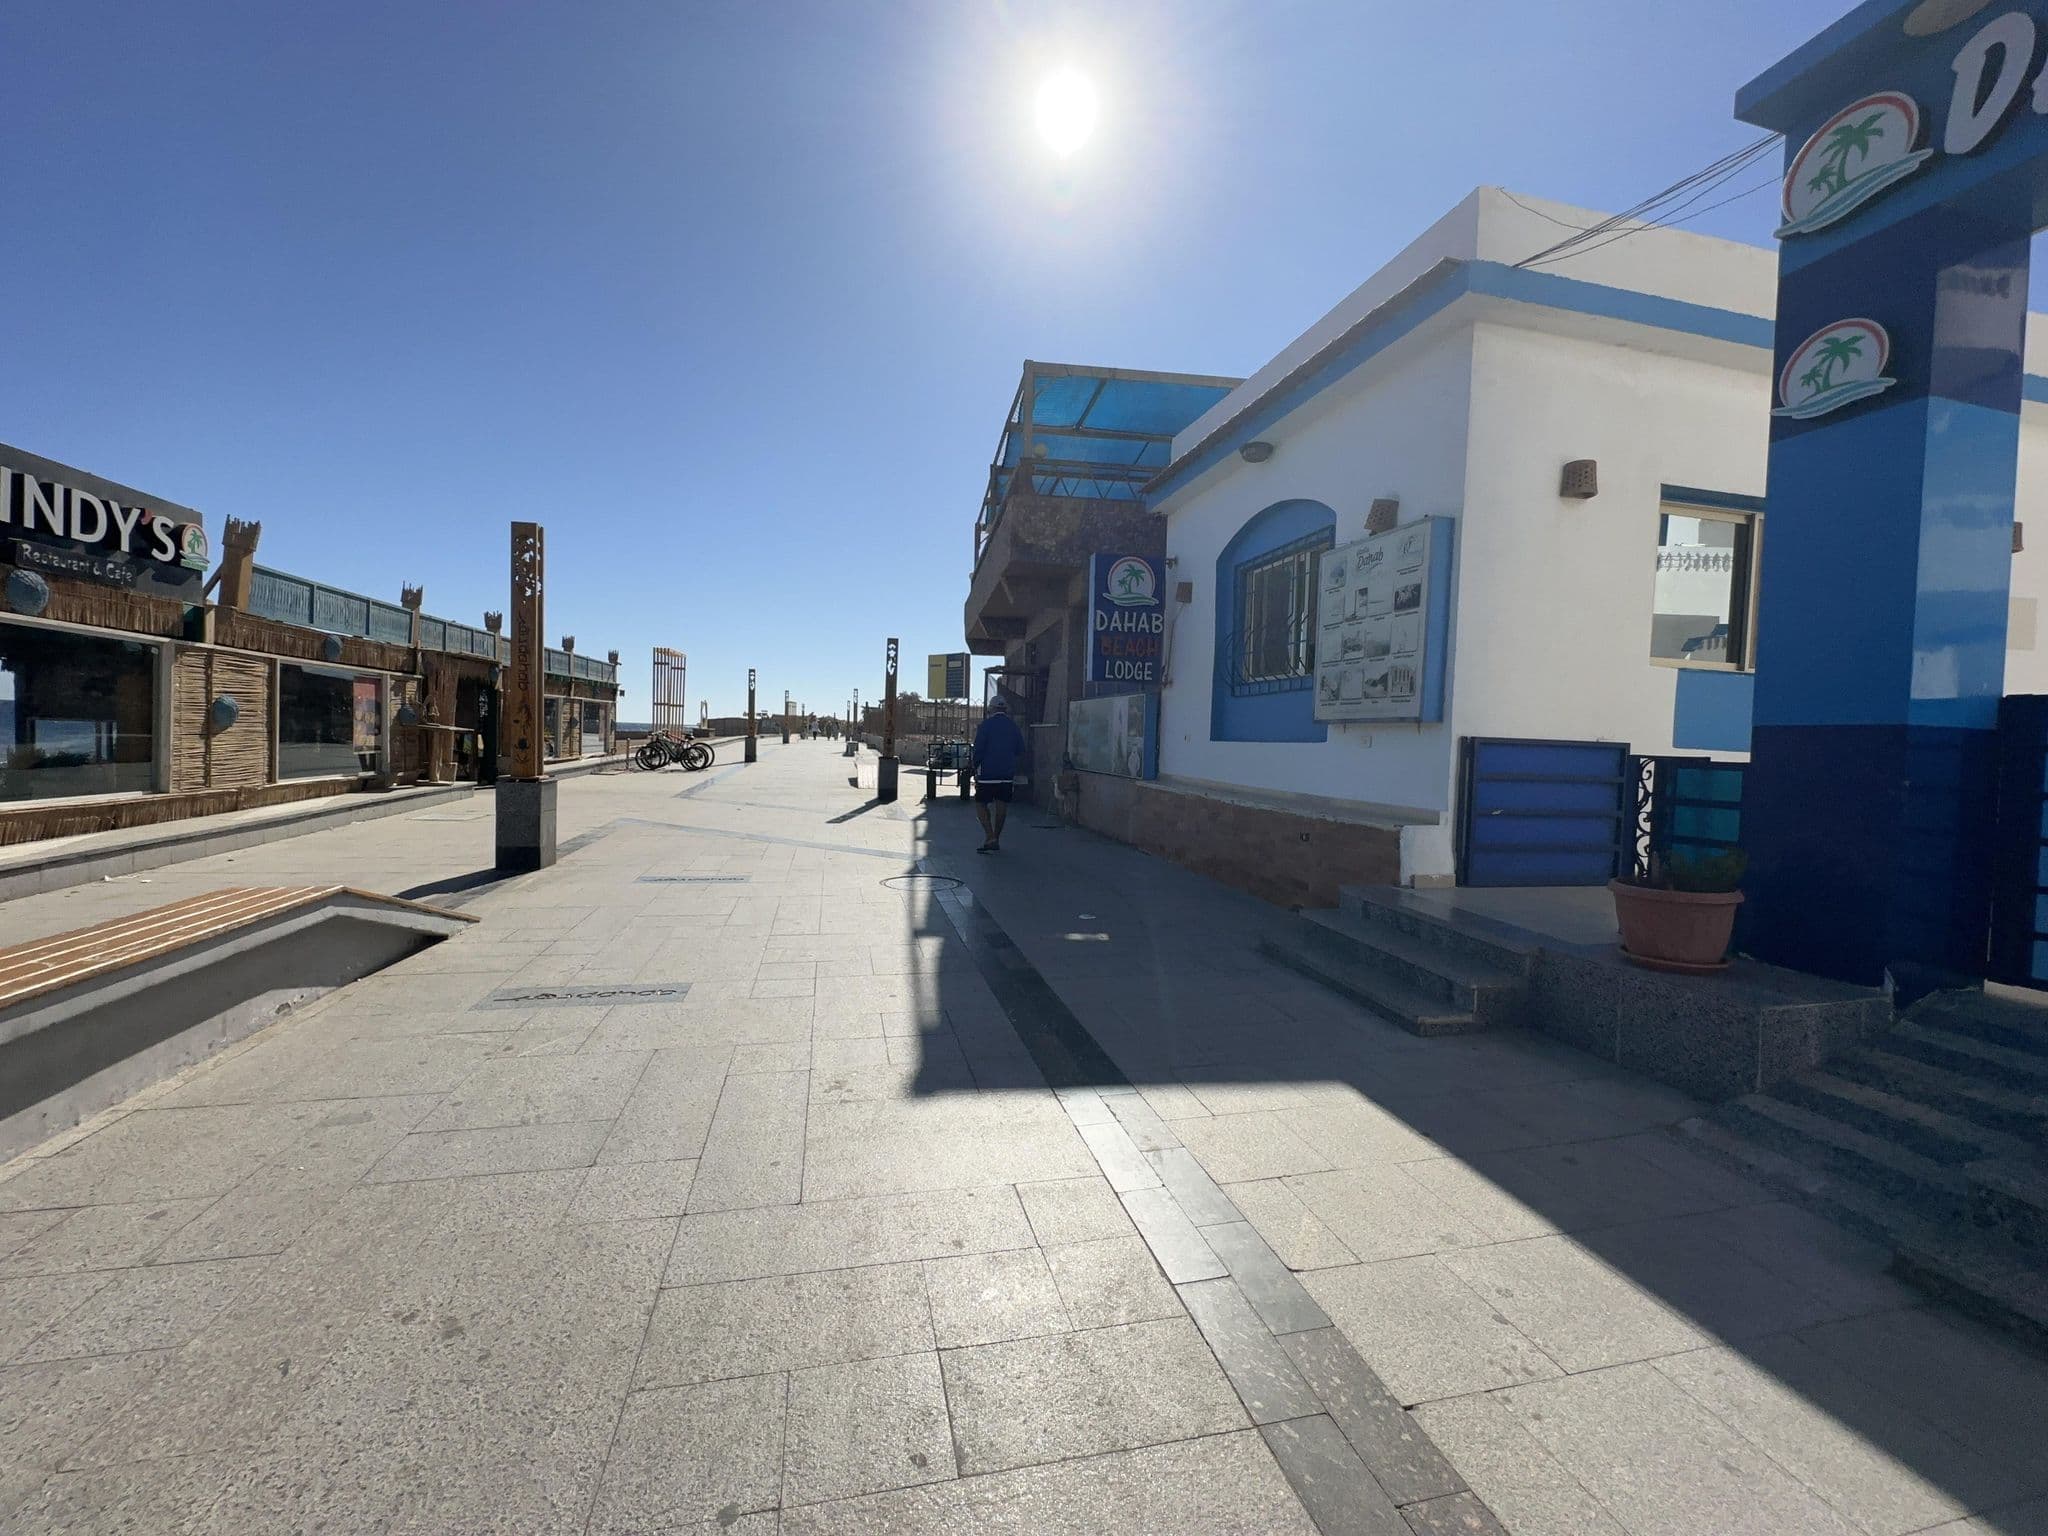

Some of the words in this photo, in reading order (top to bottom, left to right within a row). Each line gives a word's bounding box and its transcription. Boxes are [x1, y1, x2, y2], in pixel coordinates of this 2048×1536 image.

[1944, 12, 2048, 154] D
[21, 543, 91, 572] Restaurant
[93, 561, 103, 576] &
[1095, 609, 1164, 634] DAHAB
[1100, 635, 1160, 657] BEACH
[1105, 659, 1153, 681] LODGE
